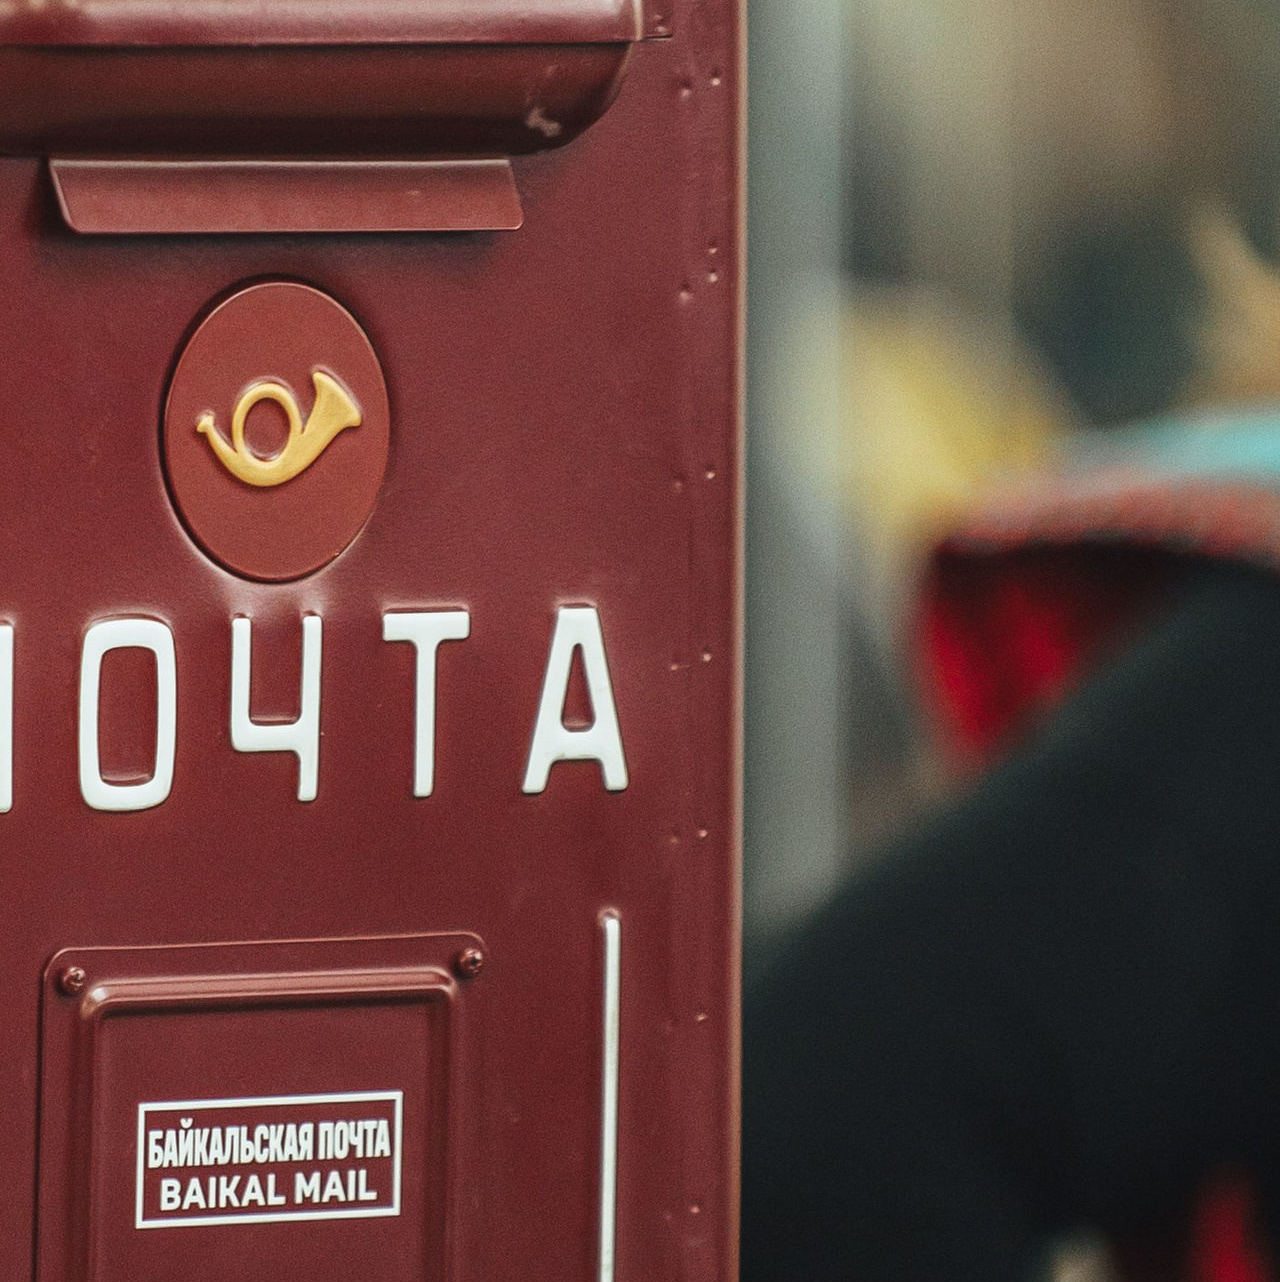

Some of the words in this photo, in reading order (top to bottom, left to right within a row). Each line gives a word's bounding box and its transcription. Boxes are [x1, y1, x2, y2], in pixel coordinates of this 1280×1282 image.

[147, 1117, 315, 1169] БАЙКАЛЬСКАЯ
[317, 1119, 391, 1160] ПОЧТА
[160, 1173, 287, 1211] BAIKAL
[294, 1169, 378, 1204] MAIL
